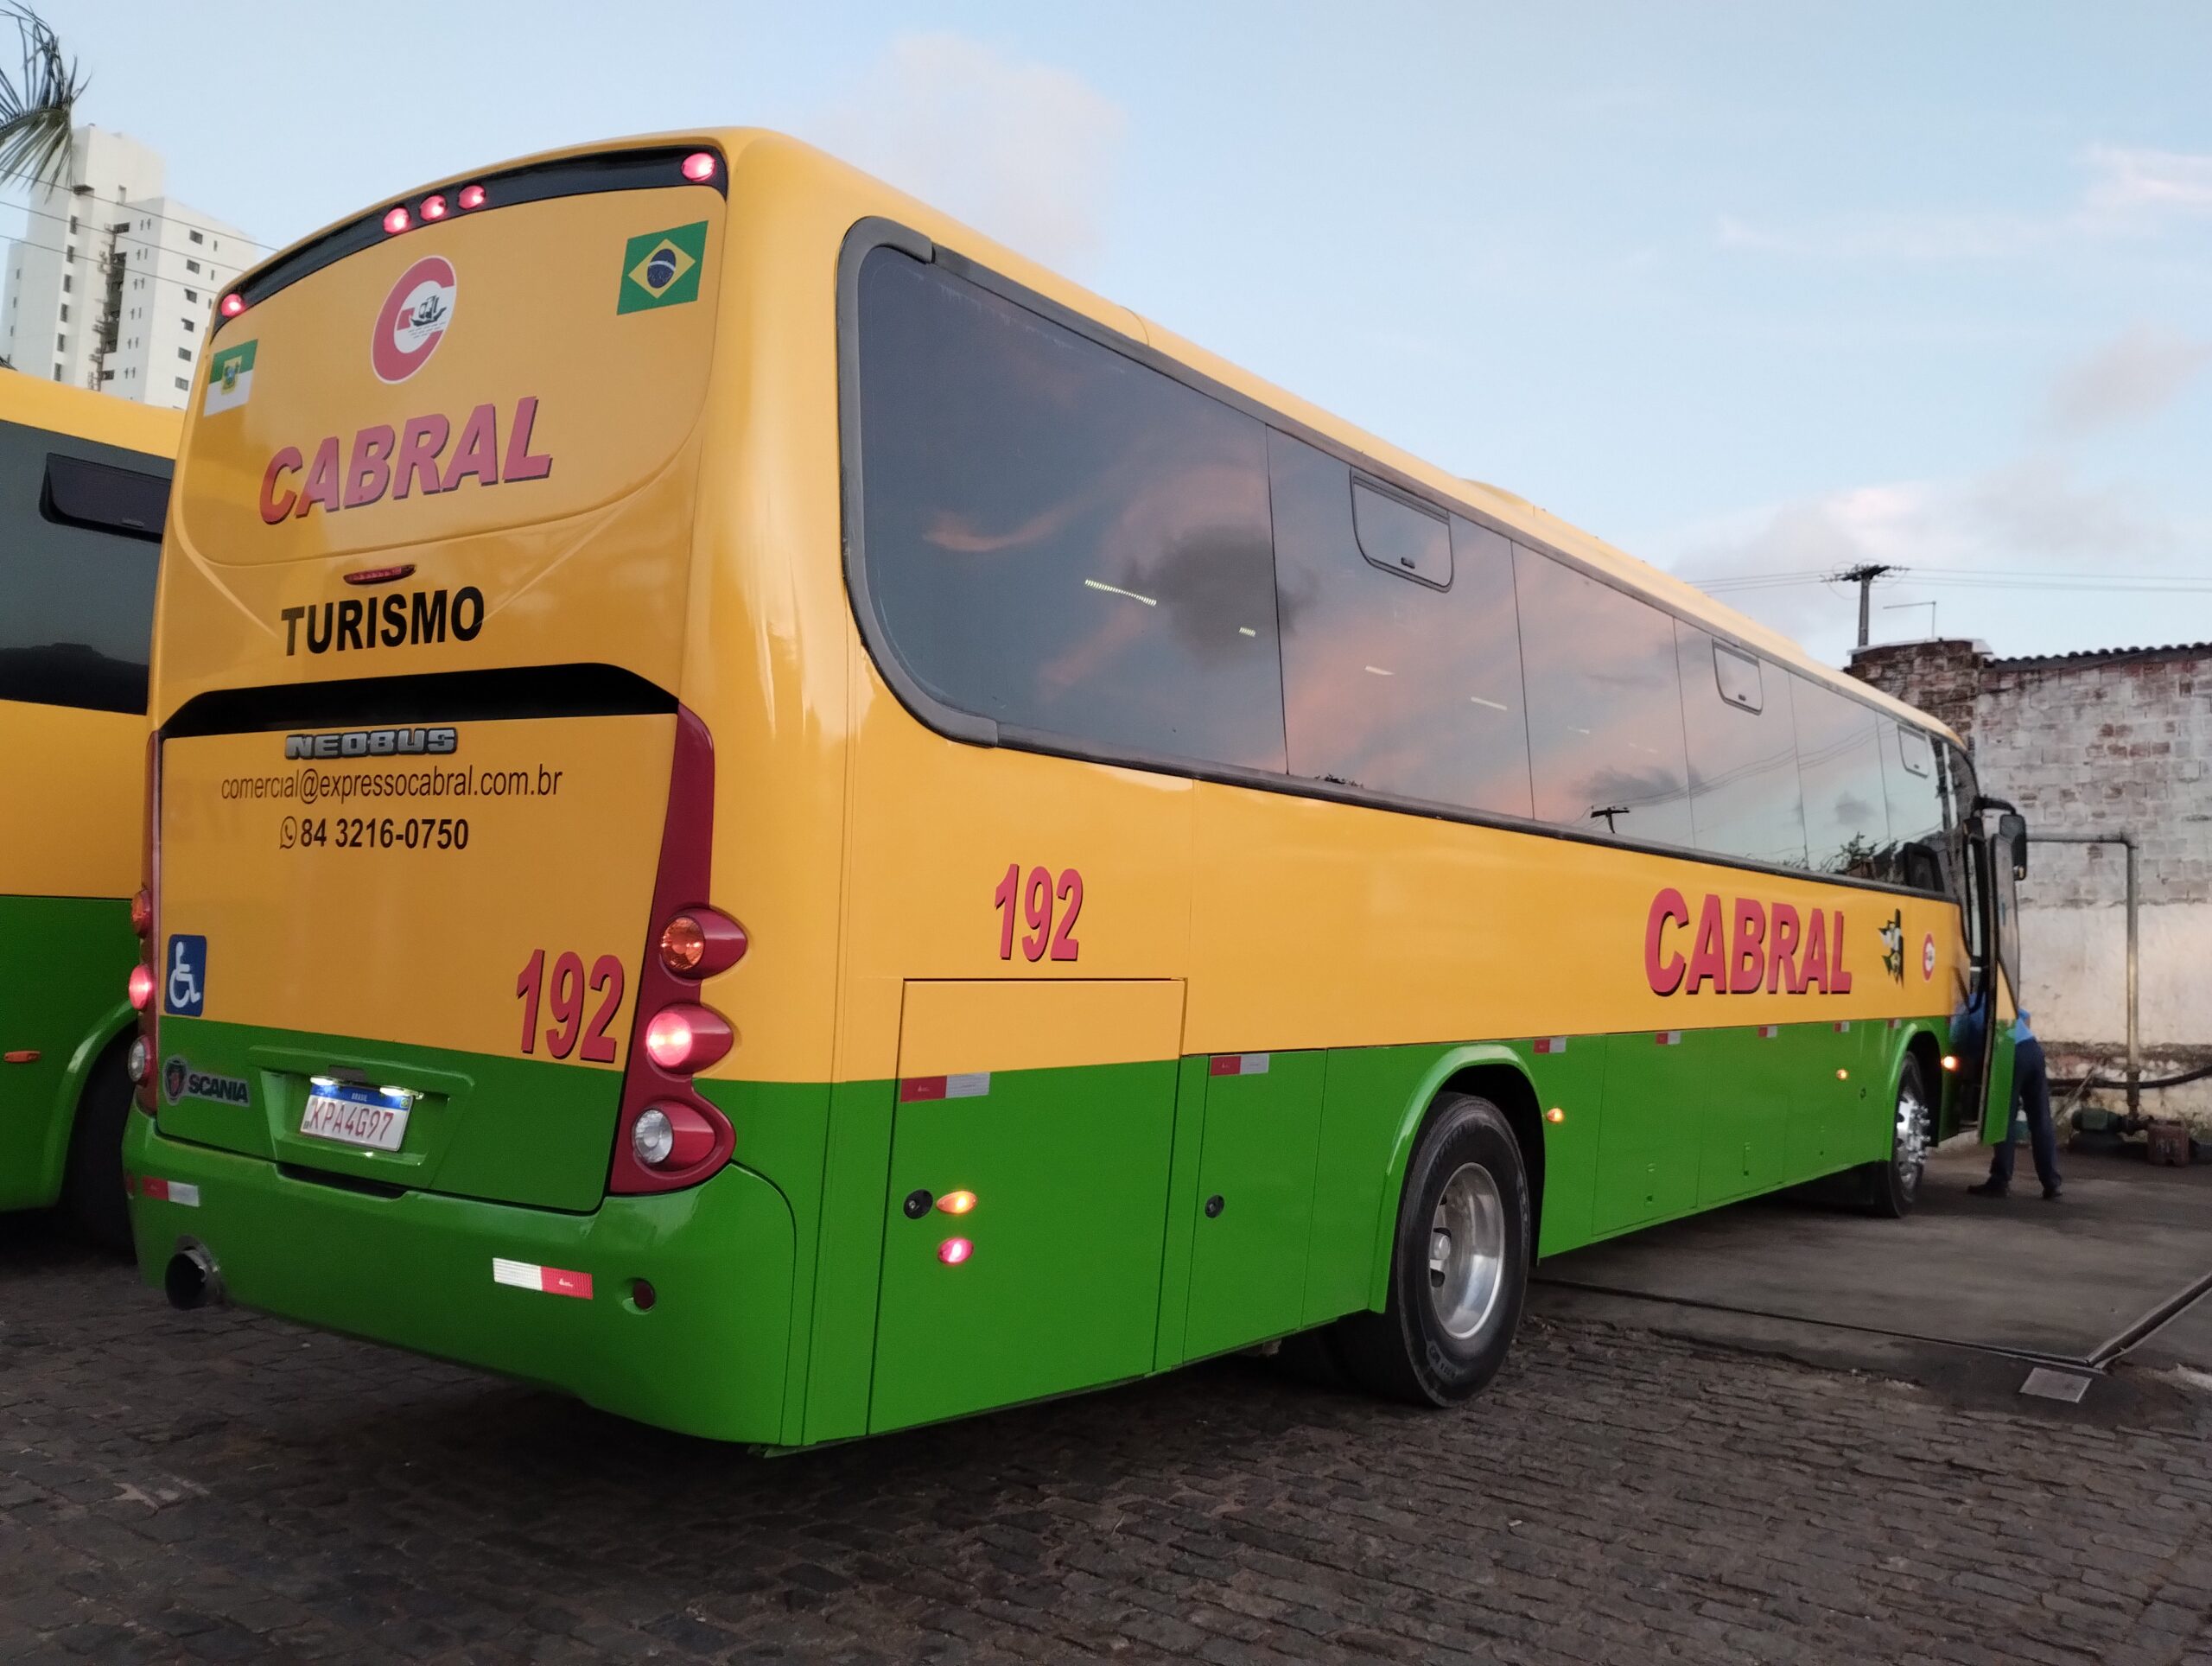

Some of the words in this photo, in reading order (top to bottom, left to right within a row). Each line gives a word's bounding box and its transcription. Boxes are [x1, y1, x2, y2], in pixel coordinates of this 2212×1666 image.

[261, 397, 551, 525] CABRAL
[281, 586, 485, 657] TURISMO
[284, 728, 457, 760] NEOBUS
[221, 764, 563, 804] comercial@expressocabral.com.br
[300, 817, 327, 848] 84
[335, 817, 469, 850] 3216-0750
[995, 863, 1084, 962] 192
[1644, 887, 1852, 996] CABRAL
[517, 949, 625, 1064] 192
[188, 1074, 248, 1103] SCANIA
[310, 1099, 394, 1141] KPA4G97
